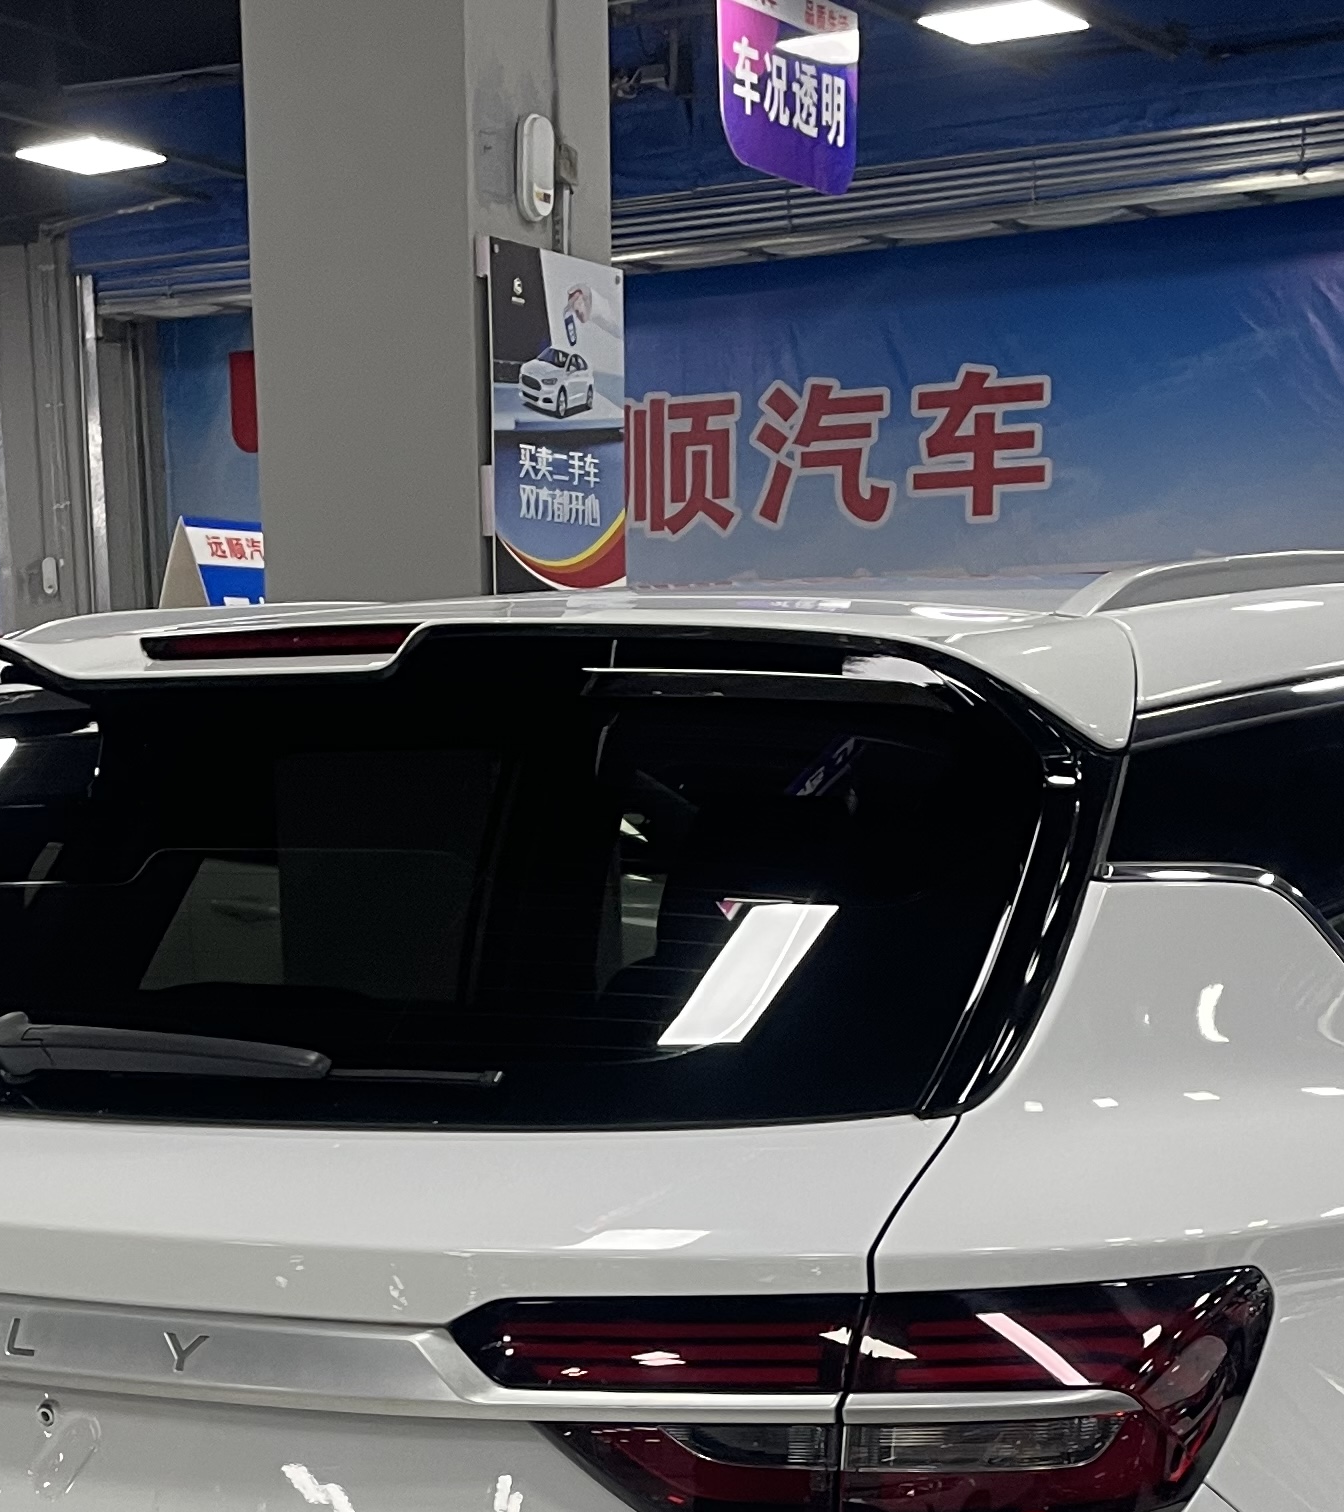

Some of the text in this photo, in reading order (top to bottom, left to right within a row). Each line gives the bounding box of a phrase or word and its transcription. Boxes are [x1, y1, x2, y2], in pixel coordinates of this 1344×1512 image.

[733, 36, 846, 148] 车况透明
[518, 443, 601, 488] 买卖二手车
[518, 484, 602, 528] 双方都开心
